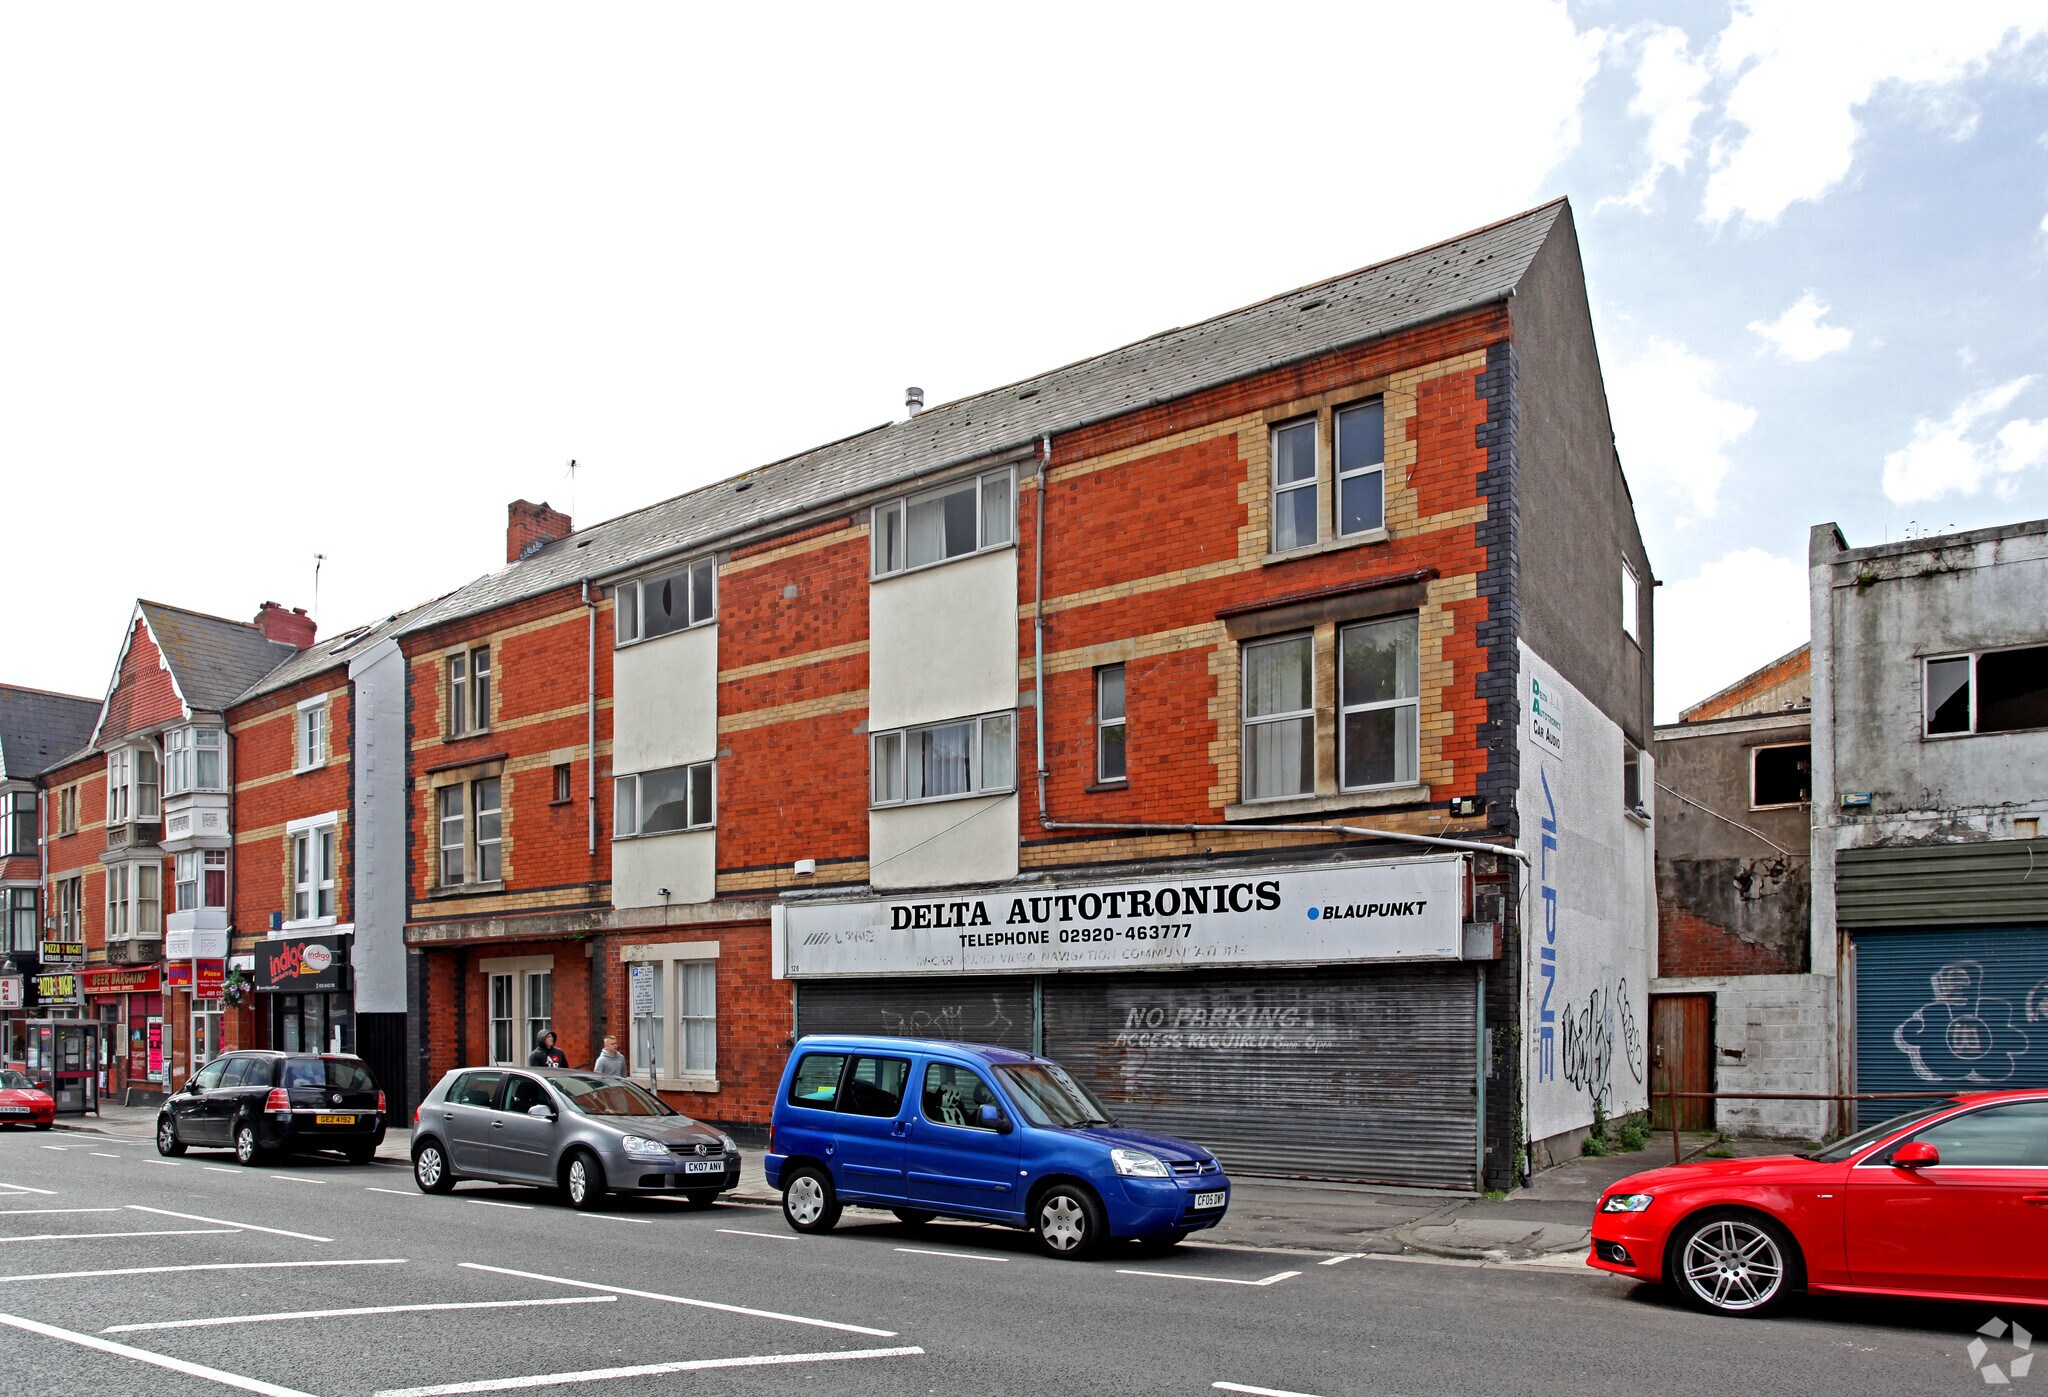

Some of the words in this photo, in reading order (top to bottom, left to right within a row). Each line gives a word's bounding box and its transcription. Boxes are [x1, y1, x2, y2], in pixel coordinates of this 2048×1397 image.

[890, 901, 991, 930] DELTA
[1006, 881, 1281, 924] AUTOTRONICS
[1322, 900, 1428, 920] BLAUPUNKT
[1540, 764, 1558, 1084] ALPINE
[959, 931, 1050, 948] TELEPHONE
[1059, 923, 1192, 943] 02920-463777
[92, 974, 110, 986] BEER
[111, 972, 147, 985] BARGAINS
[203, 969, 221, 977] Pizza
[1125, 1007, 1165, 1029] NO
[1114, 1032, 1184, 1049] ACCESS
[1188, 1032, 1269, 1051] REQUIRED
[320, 1115, 335, 1123] GEZ
[335, 1115, 352, 1123] 4192
[688, 1162, 708, 1171] CK07
[1198, 1195, 1213, 1206] CF05
